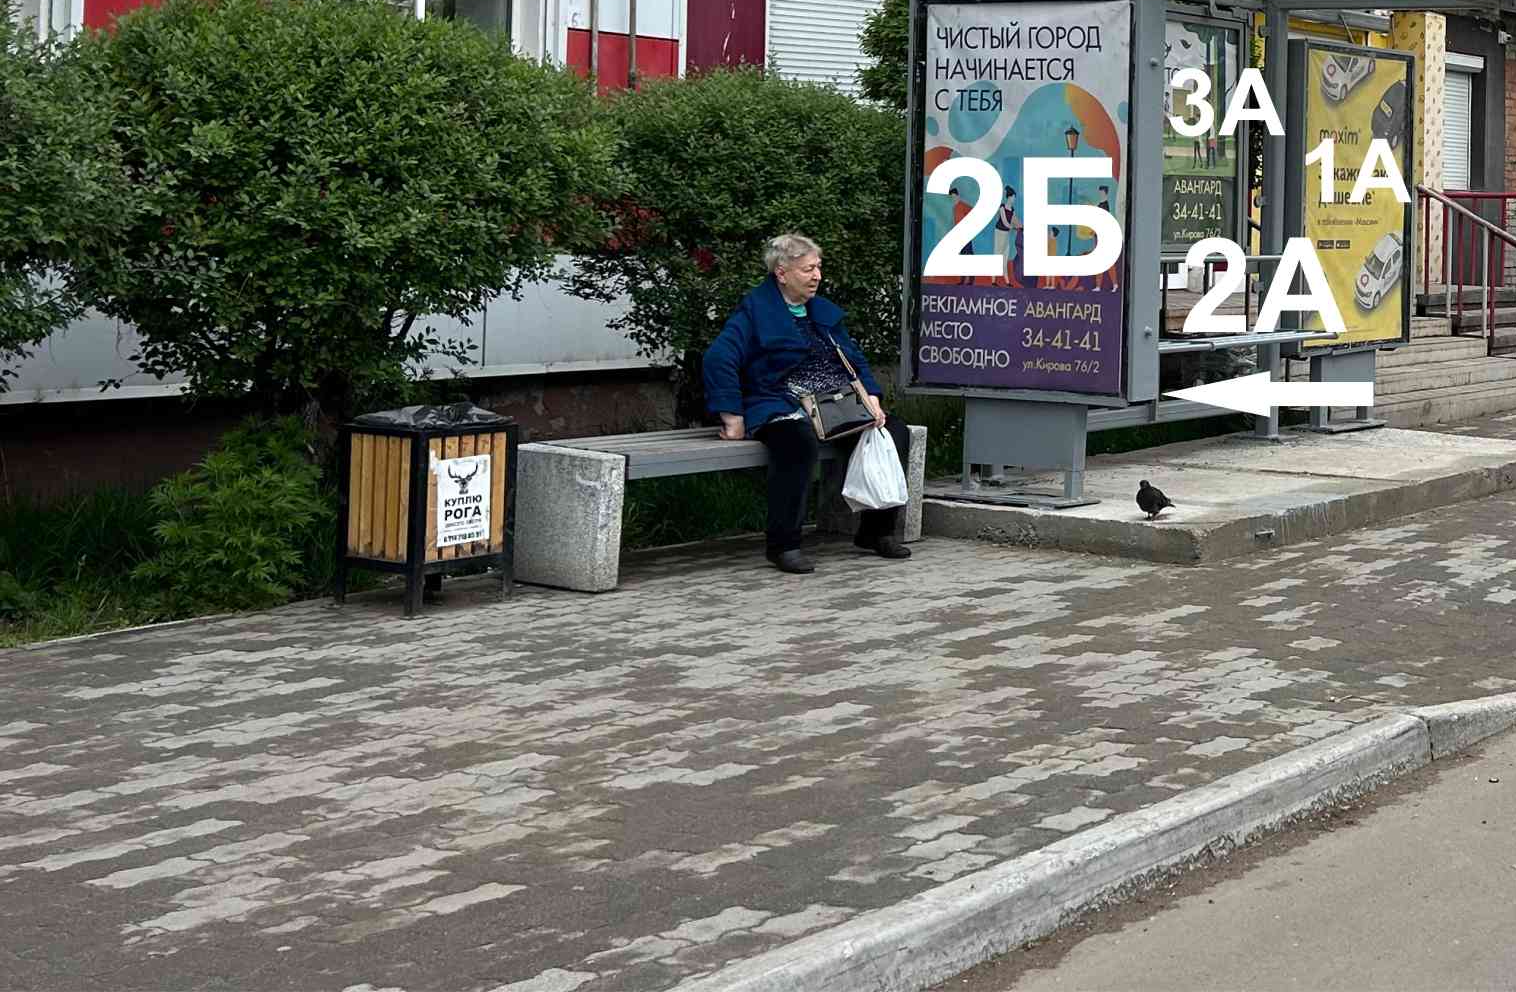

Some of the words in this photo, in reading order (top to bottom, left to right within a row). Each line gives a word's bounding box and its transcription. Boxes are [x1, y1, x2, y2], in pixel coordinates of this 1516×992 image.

[936, 21, 1021, 50] ЧИСТЫЙ
[1028, 25, 1102, 52] ГОРОД
[935, 58, 1075, 81] НАЧИНАЕТСЯ
[934, 88, 949, 112] С
[957, 89, 1003, 112] ТЕБЯ
[1174, 179, 1222, 197] АВАНГАРД
[1173, 201, 1222, 220] 34-41-41
[921, 295, 1018, 317] РЕКЛАМНОЕ
[1024, 301, 1102, 324] АВАНГАРД
[919, 321, 973, 340] МЕСТО
[1022, 327, 1101, 352] 34-41-41
[918, 345, 1010, 369] СВОБОДНО
[1074, 360, 1101, 374] 76/2
[444, 494, 482, 508] КУПЛЮ
[444, 505, 482, 521] РОГА
